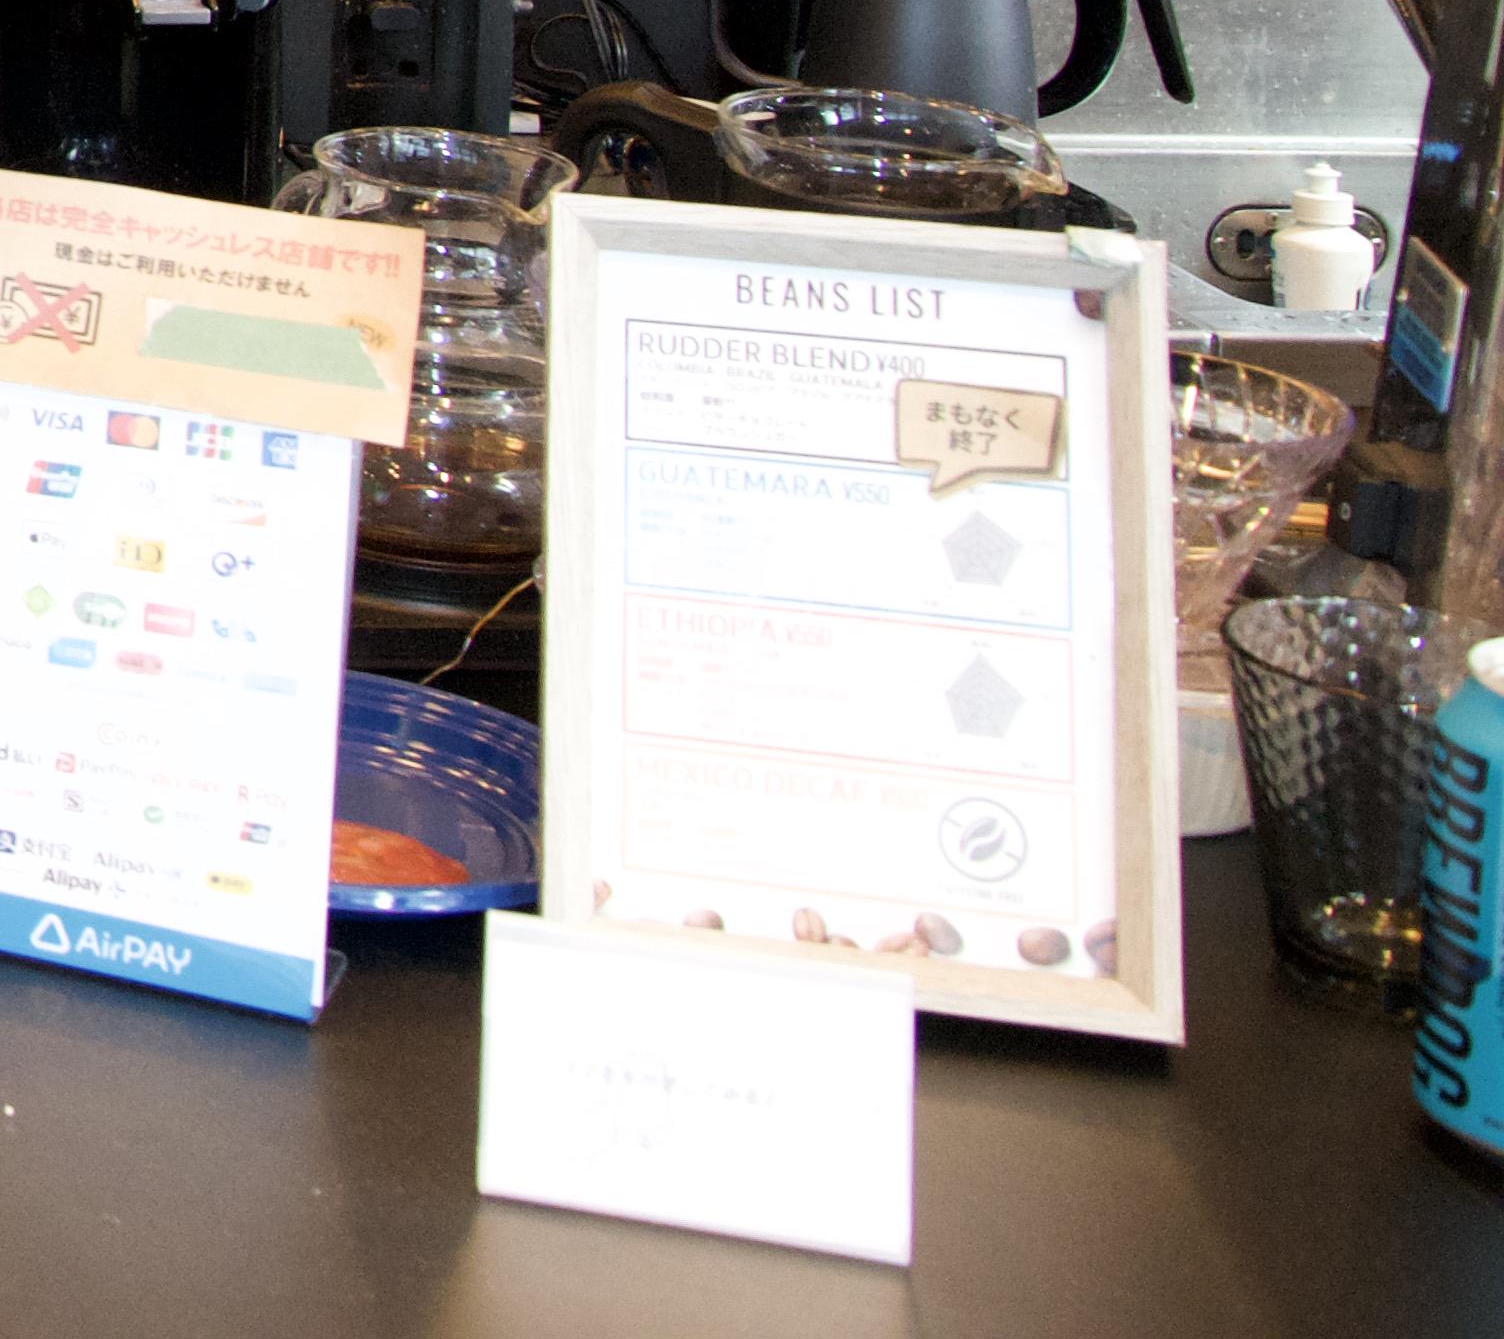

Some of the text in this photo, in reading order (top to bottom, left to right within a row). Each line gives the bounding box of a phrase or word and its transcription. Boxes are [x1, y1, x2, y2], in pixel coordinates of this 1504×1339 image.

[54, 241, 312, 300] 現金はご利用いただけません
[735, 272, 947, 322] BEANS LIST
[638, 331, 927, 380] RUDDER BLEND ¥400
[723, 365, 774, 383] BRAZIL
[785, 370, 879, 391] GUATEMALA
[31, 407, 85, 433] VISA
[924, 400, 1022, 431] まもなく
[947, 430, 999, 457] 終了
[638, 457, 829, 497] GUATEMARA
[636, 605, 777, 643] ETHIOPIA
[75, 925, 194, 977] AirPAY
